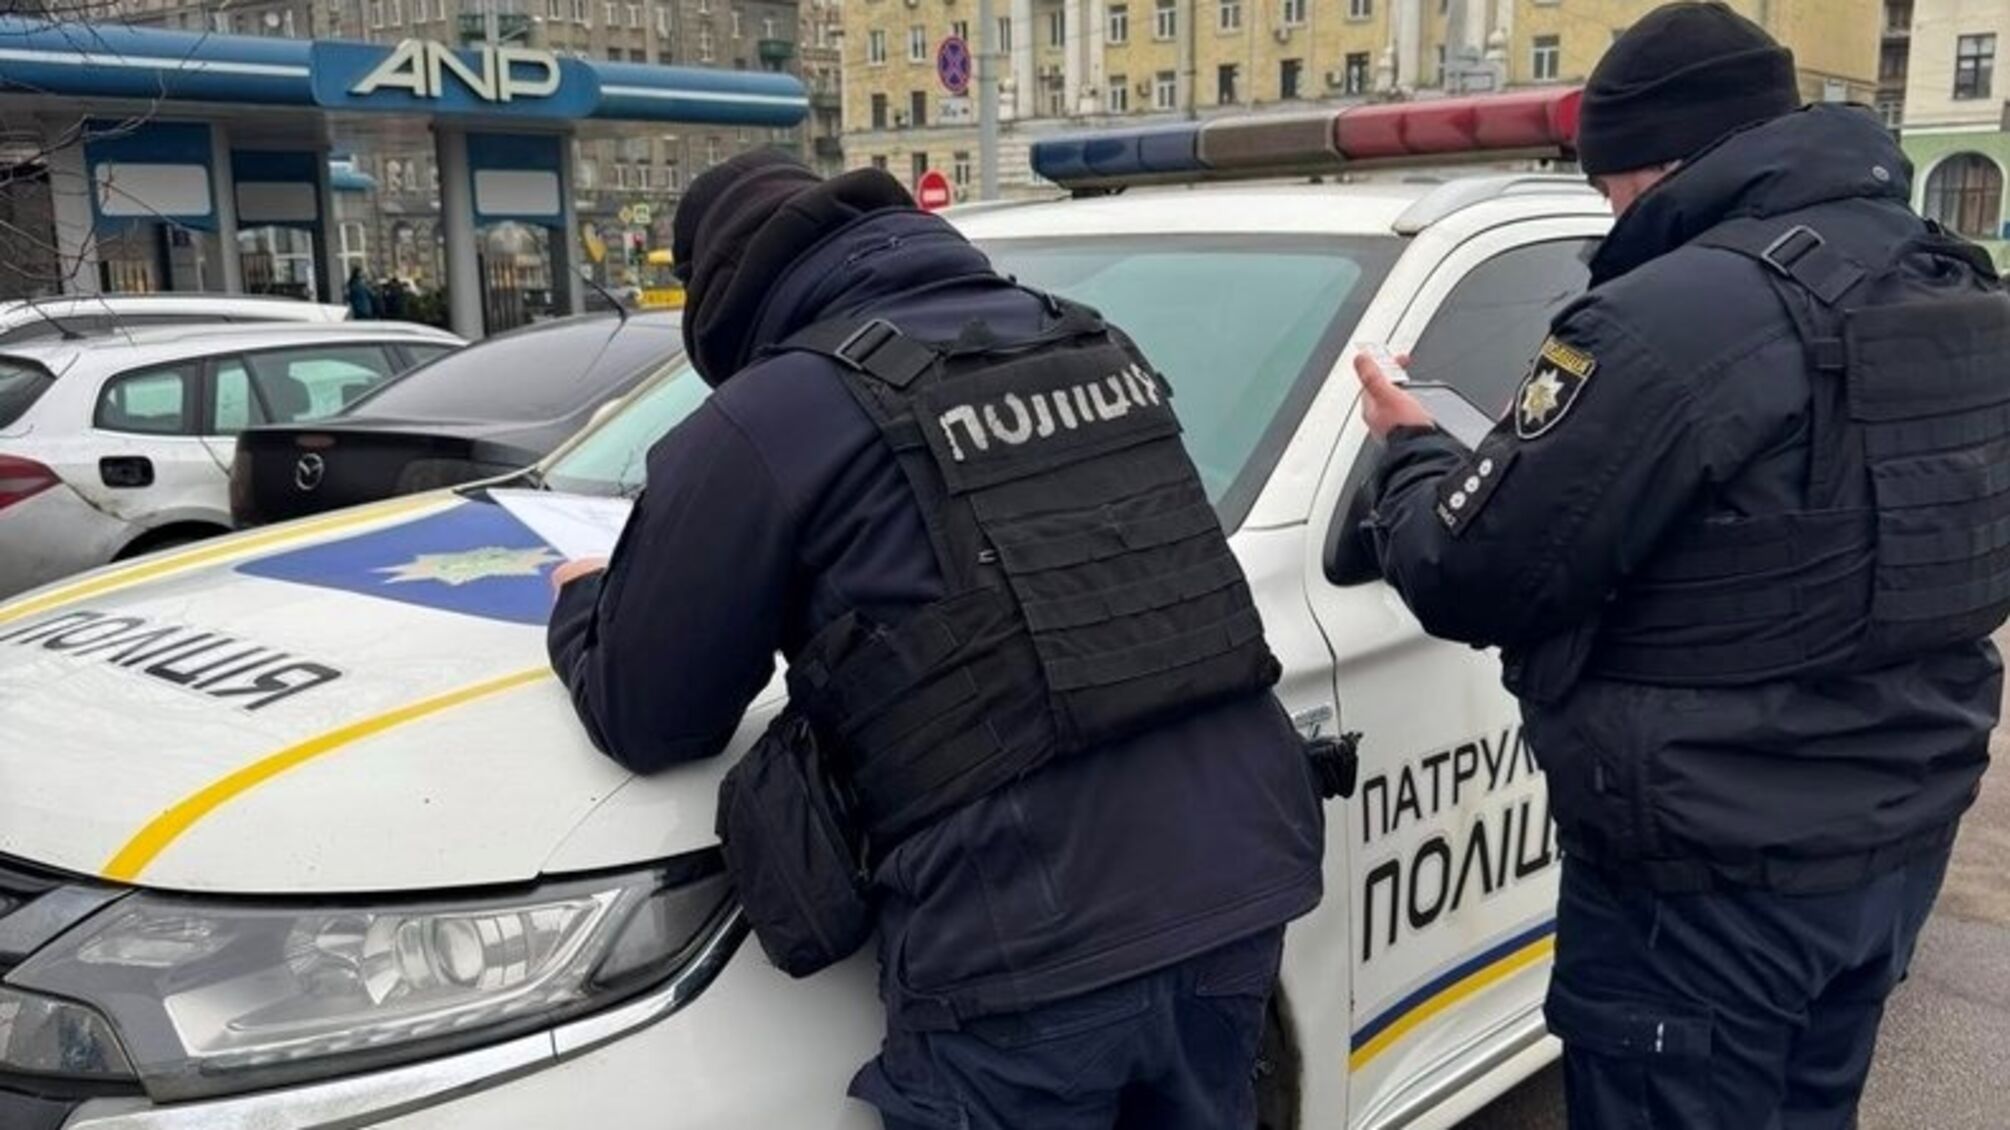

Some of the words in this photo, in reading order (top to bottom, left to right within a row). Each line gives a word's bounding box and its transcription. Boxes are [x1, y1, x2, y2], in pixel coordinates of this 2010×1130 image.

[351, 38, 561, 102] ANP
[0, 610, 342, 711] ПОЛІЦІЯ
[1362, 725, 1536, 844] ПАТРУЛ
[1362, 802, 1561, 963] ПОЛІЦ
